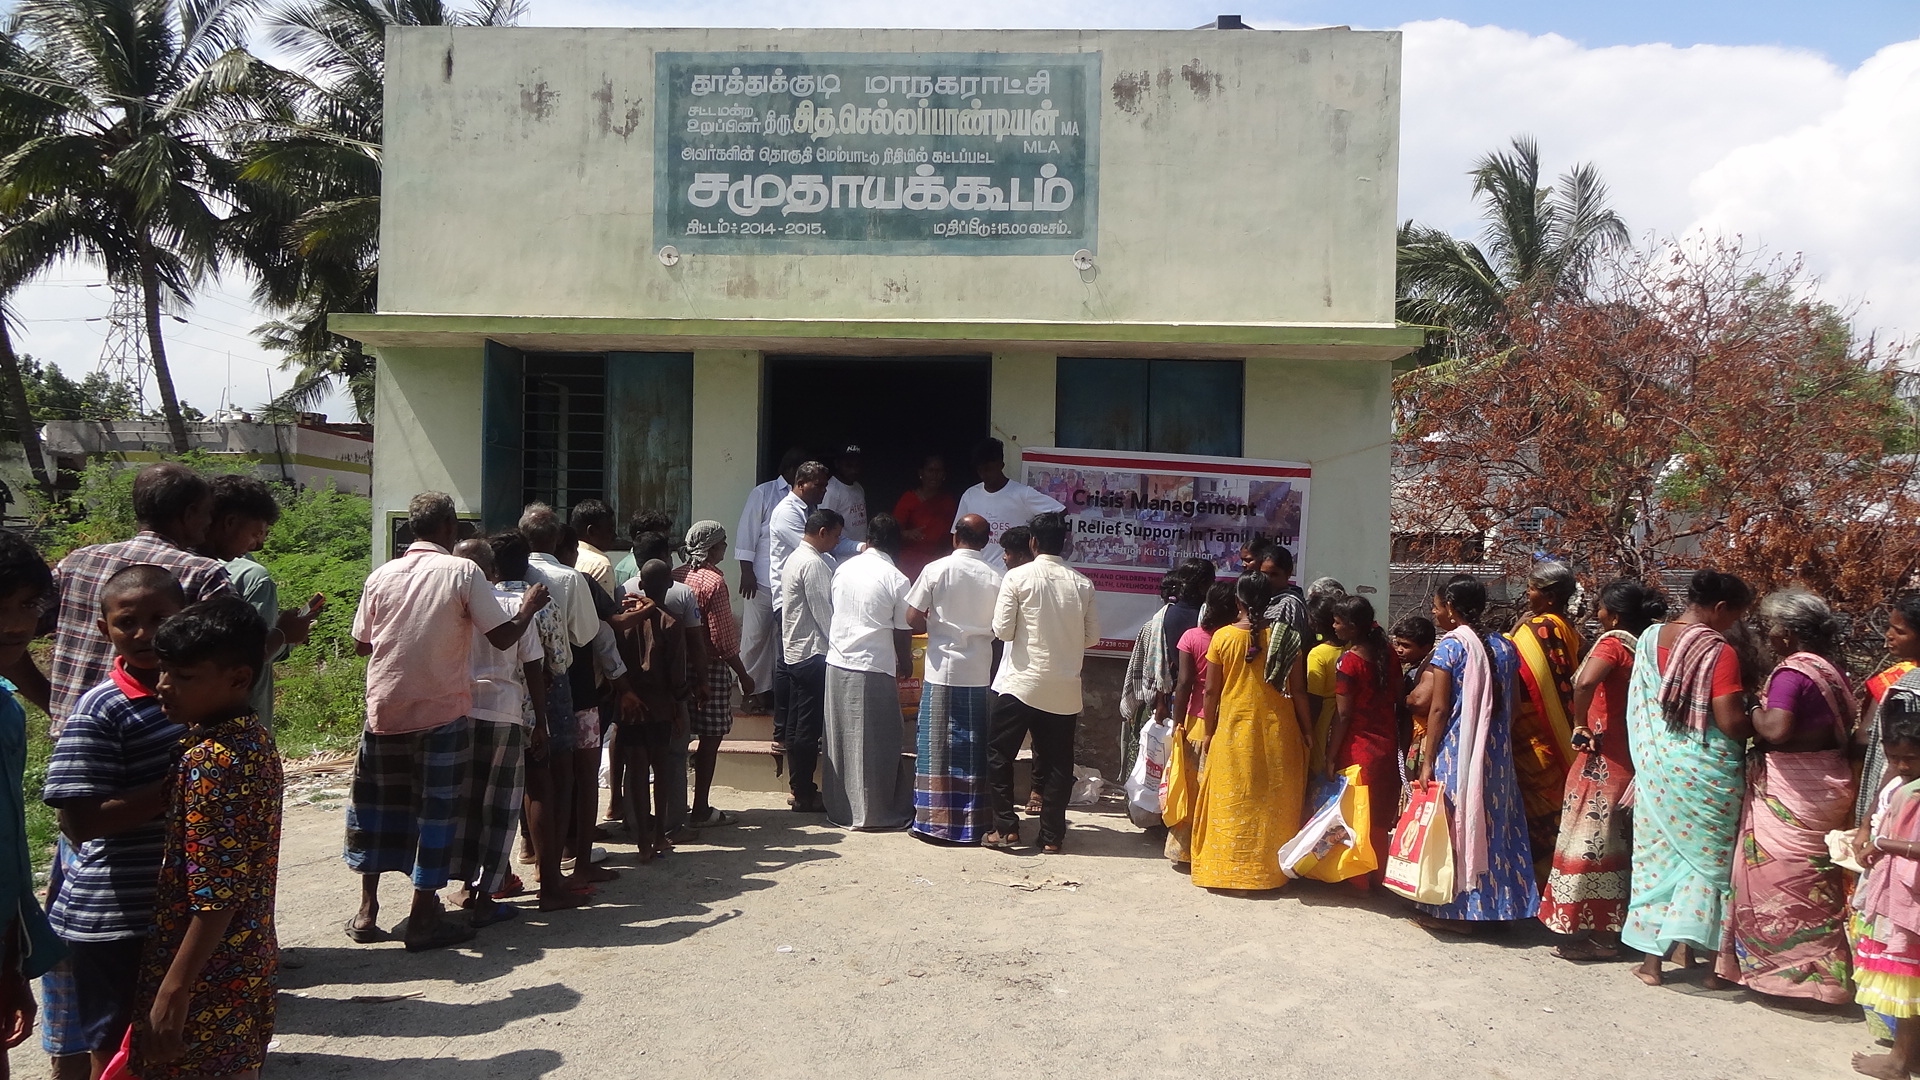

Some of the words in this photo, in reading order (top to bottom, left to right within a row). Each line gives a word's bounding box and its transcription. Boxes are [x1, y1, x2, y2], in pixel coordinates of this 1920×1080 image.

[691, 66, 841, 99] தூத்துக்குடி
[865, 69, 1050, 99] மாநகராட்சி
[686, 118, 761, 136] உறுப்பினர்
[1061, 121, 1080, 136] MA
[681, 144, 756, 162] அவர்களின்
[759, 145, 813, 166] தொகுதி
[816, 145, 880, 165] மேம்பாட்டு
[881, 146, 928, 165] நிதியில்
[932, 148, 995, 164] கட்டப்பட்ட
[1023, 140, 1060, 154] MLA
[687, 163, 1074, 217] சமுதாயக்கூடம்
[1072, 489, 1124, 508] Crisis
[1130, 491, 1257, 517] Management
[1078, 520, 1122, 536] Relief
[1124, 522, 1185, 542] Support
[1189, 526, 1203, 541] in
[1207, 528, 1250, 543] Tamil
[1255, 530, 1292, 546] Ndu
[1111, 546, 1141, 556] Ration
[1144, 548, 1157, 557] Kit
[1158, 548, 1213, 560] Distribution
[1116, 581, 1154, 590] LIVELIHOOD
